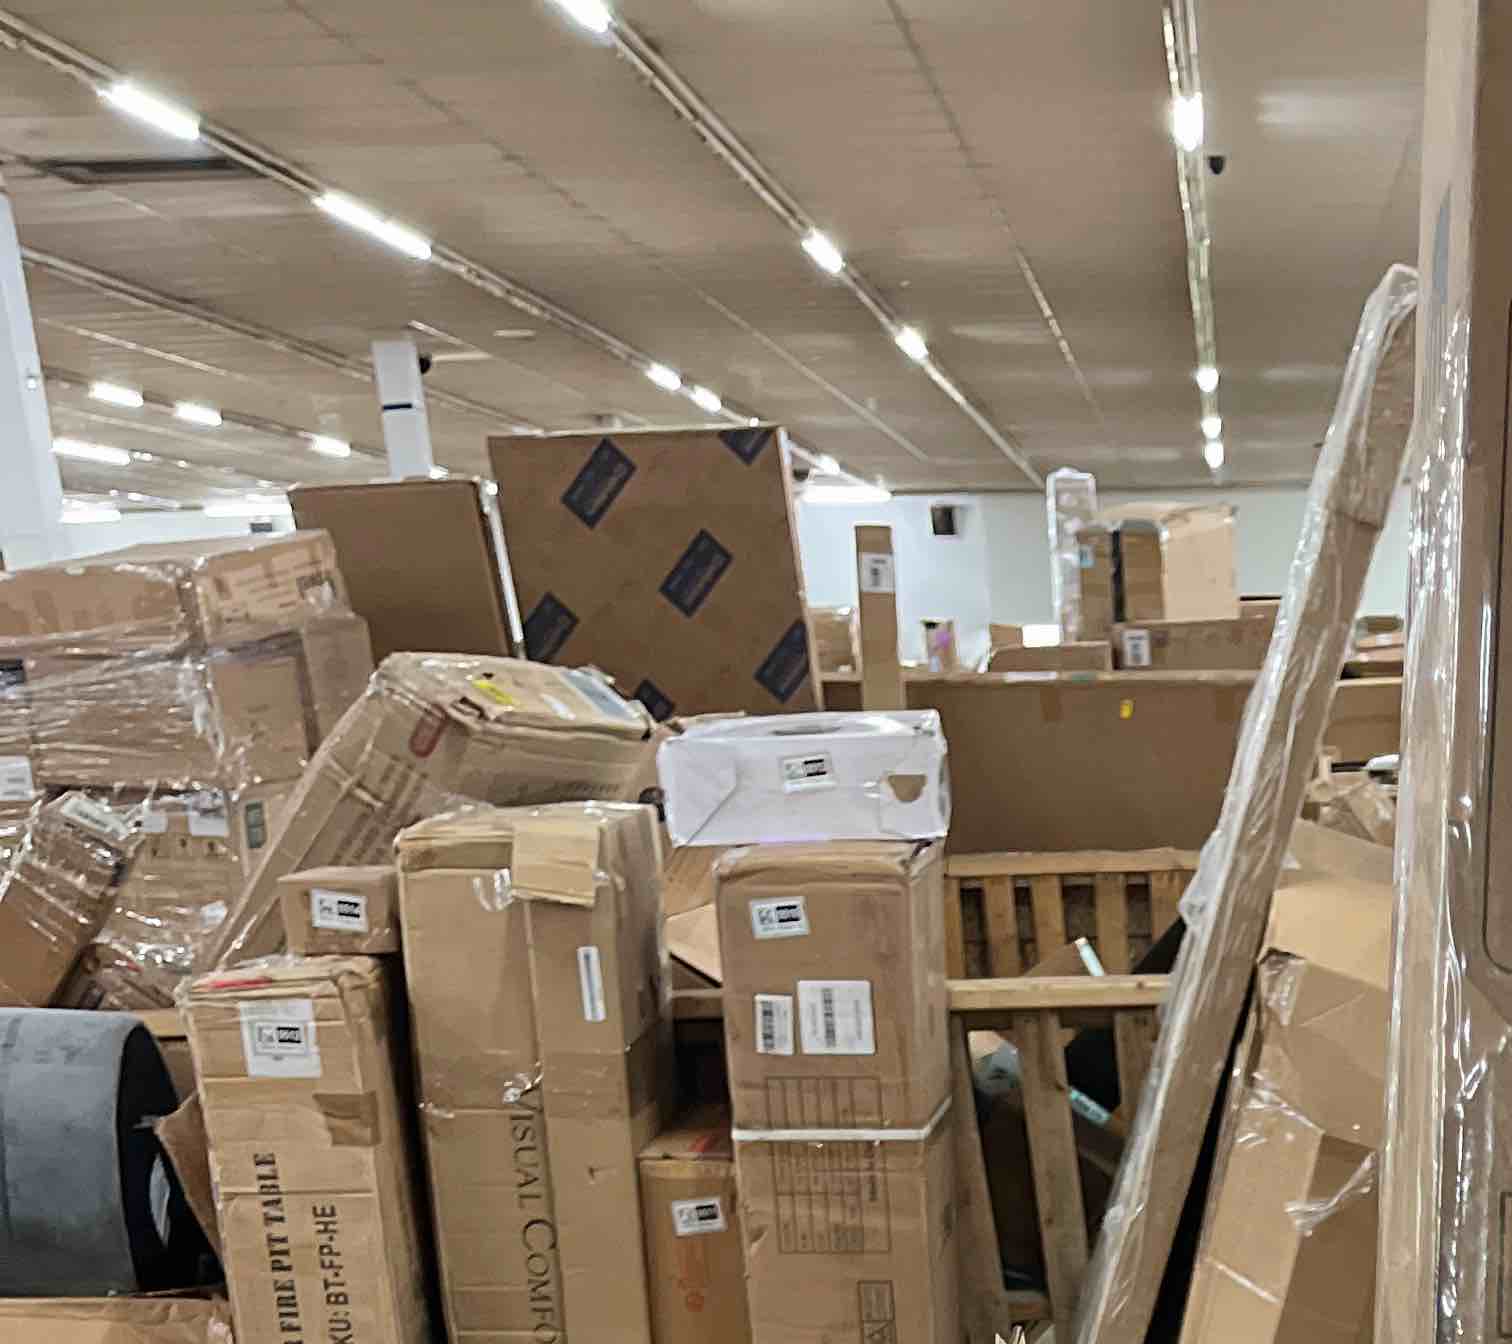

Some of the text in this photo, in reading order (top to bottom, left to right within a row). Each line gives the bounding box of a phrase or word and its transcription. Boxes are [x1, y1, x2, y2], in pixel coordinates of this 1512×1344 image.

[253, 1152, 286, 1227] TABLE
[266, 1234, 294, 1273] PIT
[273, 1279, 303, 1333] FIRE
